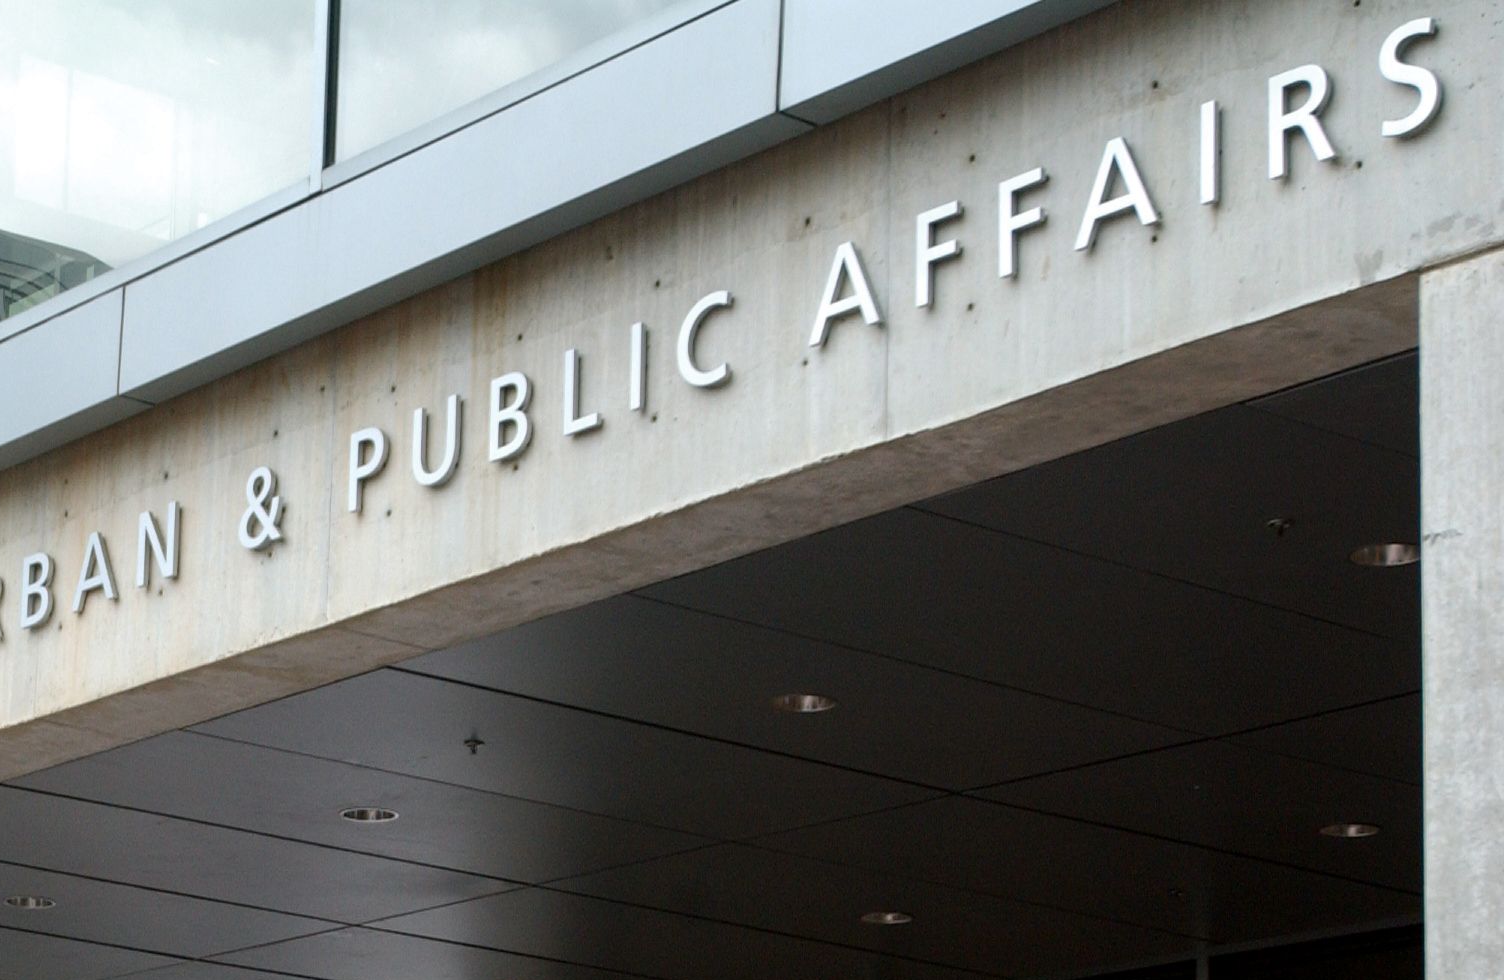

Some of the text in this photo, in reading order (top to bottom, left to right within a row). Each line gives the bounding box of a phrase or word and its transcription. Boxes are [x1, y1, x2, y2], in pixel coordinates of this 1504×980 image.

[238, 465, 285, 552] &
[348, 289, 734, 513] PUBLIC
[808, 17, 1443, 348] AFFAIRS
